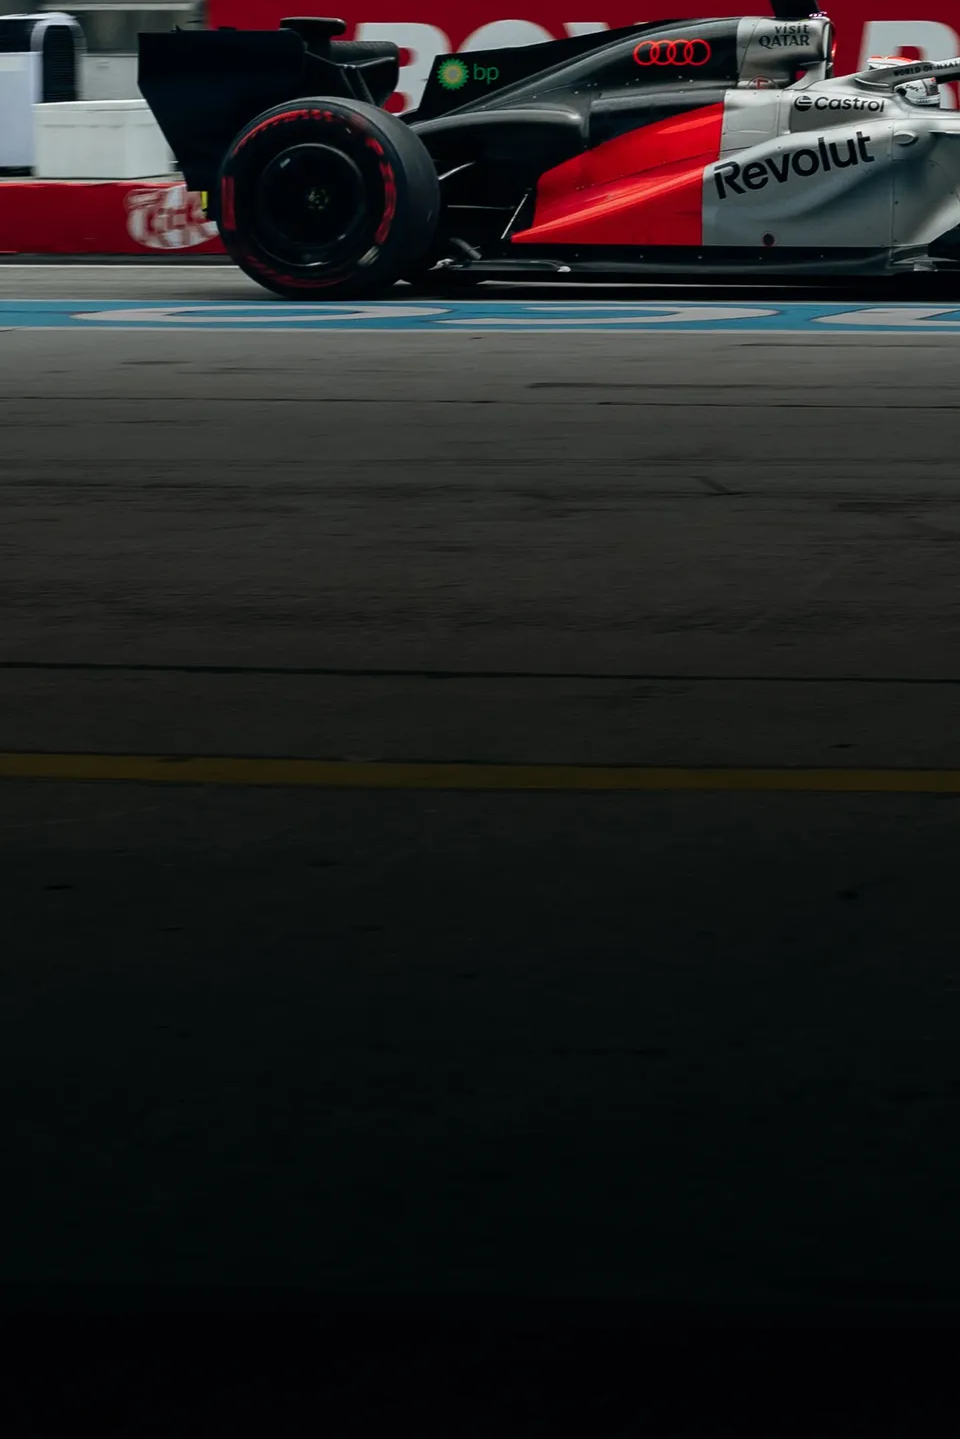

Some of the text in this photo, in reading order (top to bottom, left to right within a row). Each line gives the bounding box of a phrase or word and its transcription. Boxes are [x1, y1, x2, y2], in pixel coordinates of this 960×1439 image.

[775, 23, 810, 35] visit
[758, 34, 810, 49] QATAR
[472, 64, 500, 85] bp
[814, 96, 885, 113] Castrol
[714, 131, 875, 200] Revolut
